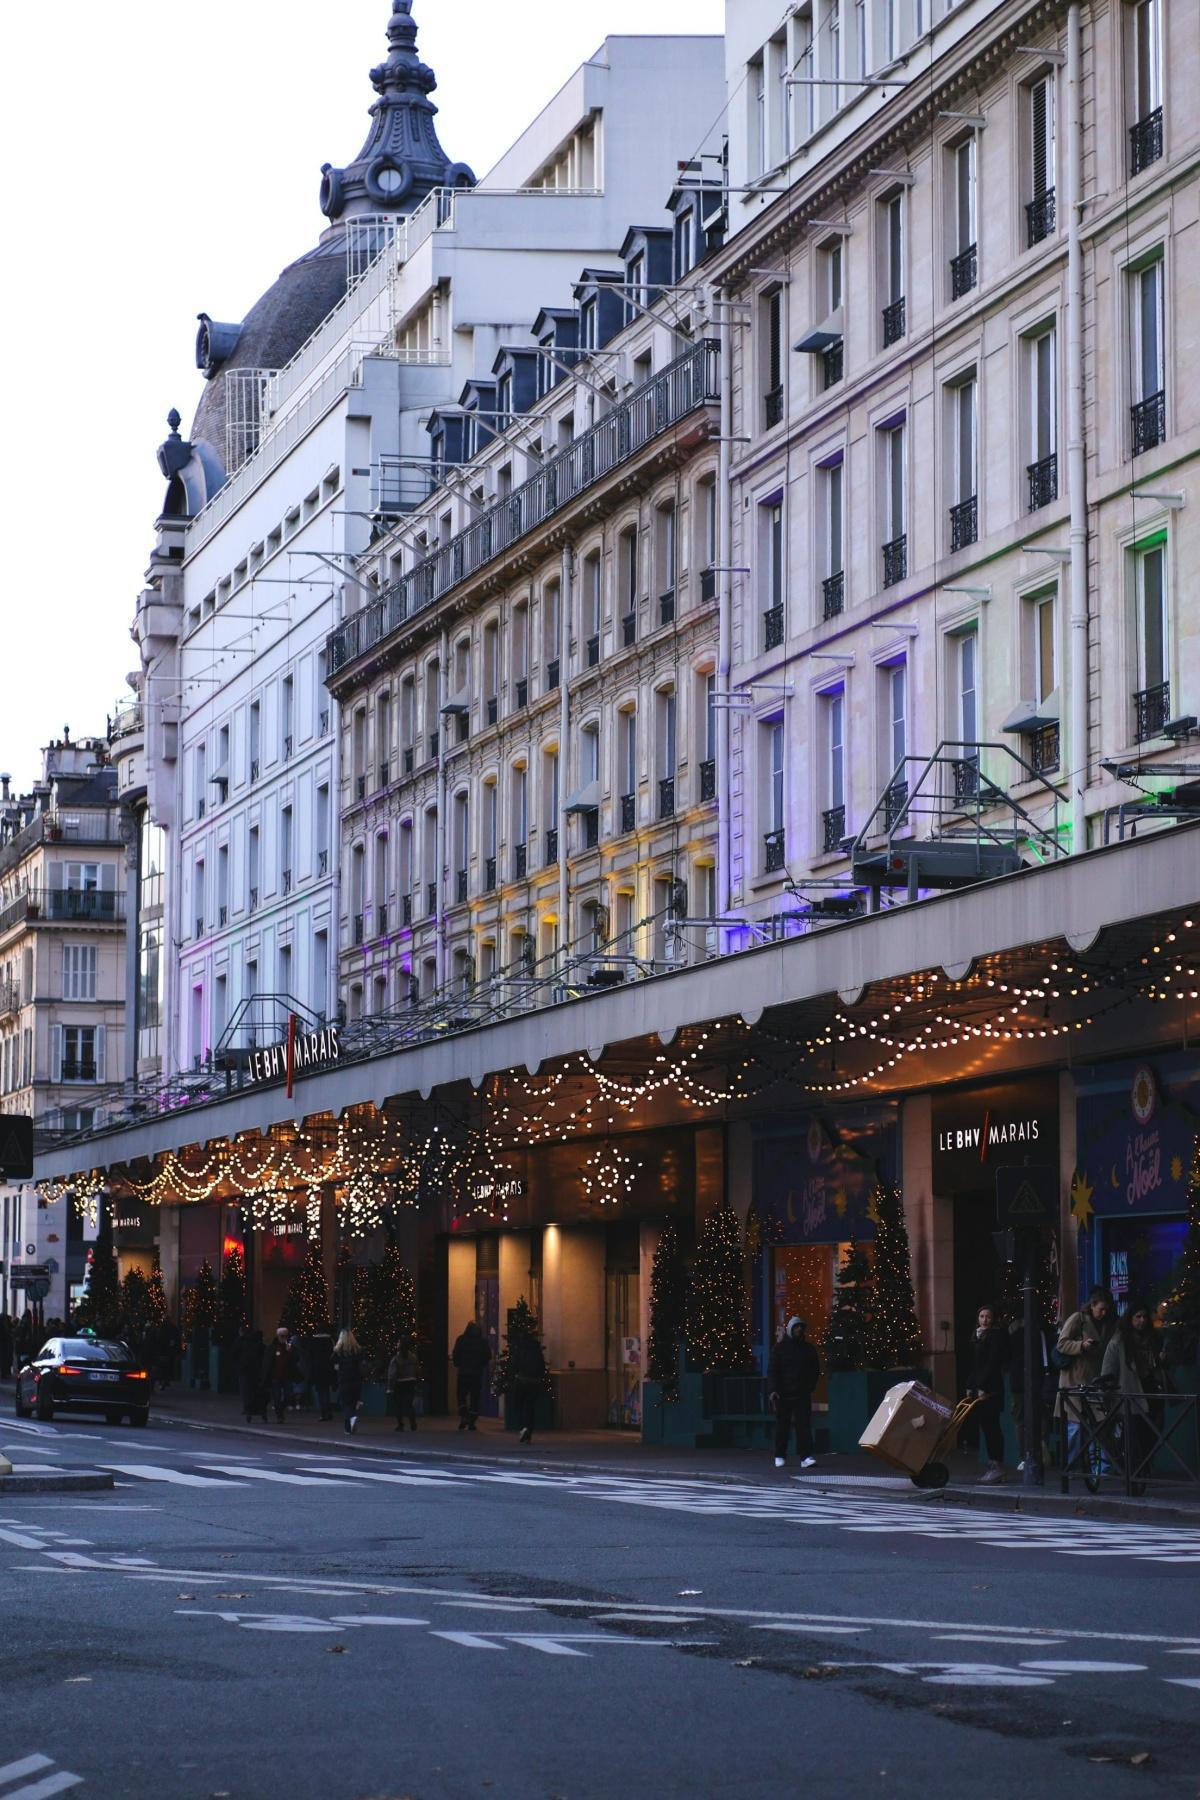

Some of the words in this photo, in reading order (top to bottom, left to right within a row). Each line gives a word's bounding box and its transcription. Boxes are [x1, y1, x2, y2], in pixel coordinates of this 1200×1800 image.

[293, 1027, 339, 1070] MARAIS
[939, 1131, 953, 1151] LE
[956, 1128, 980, 1149] BHV
[988, 1119, 1039, 1145] MARAIS
[1126, 1147, 1162, 1205] Noël
